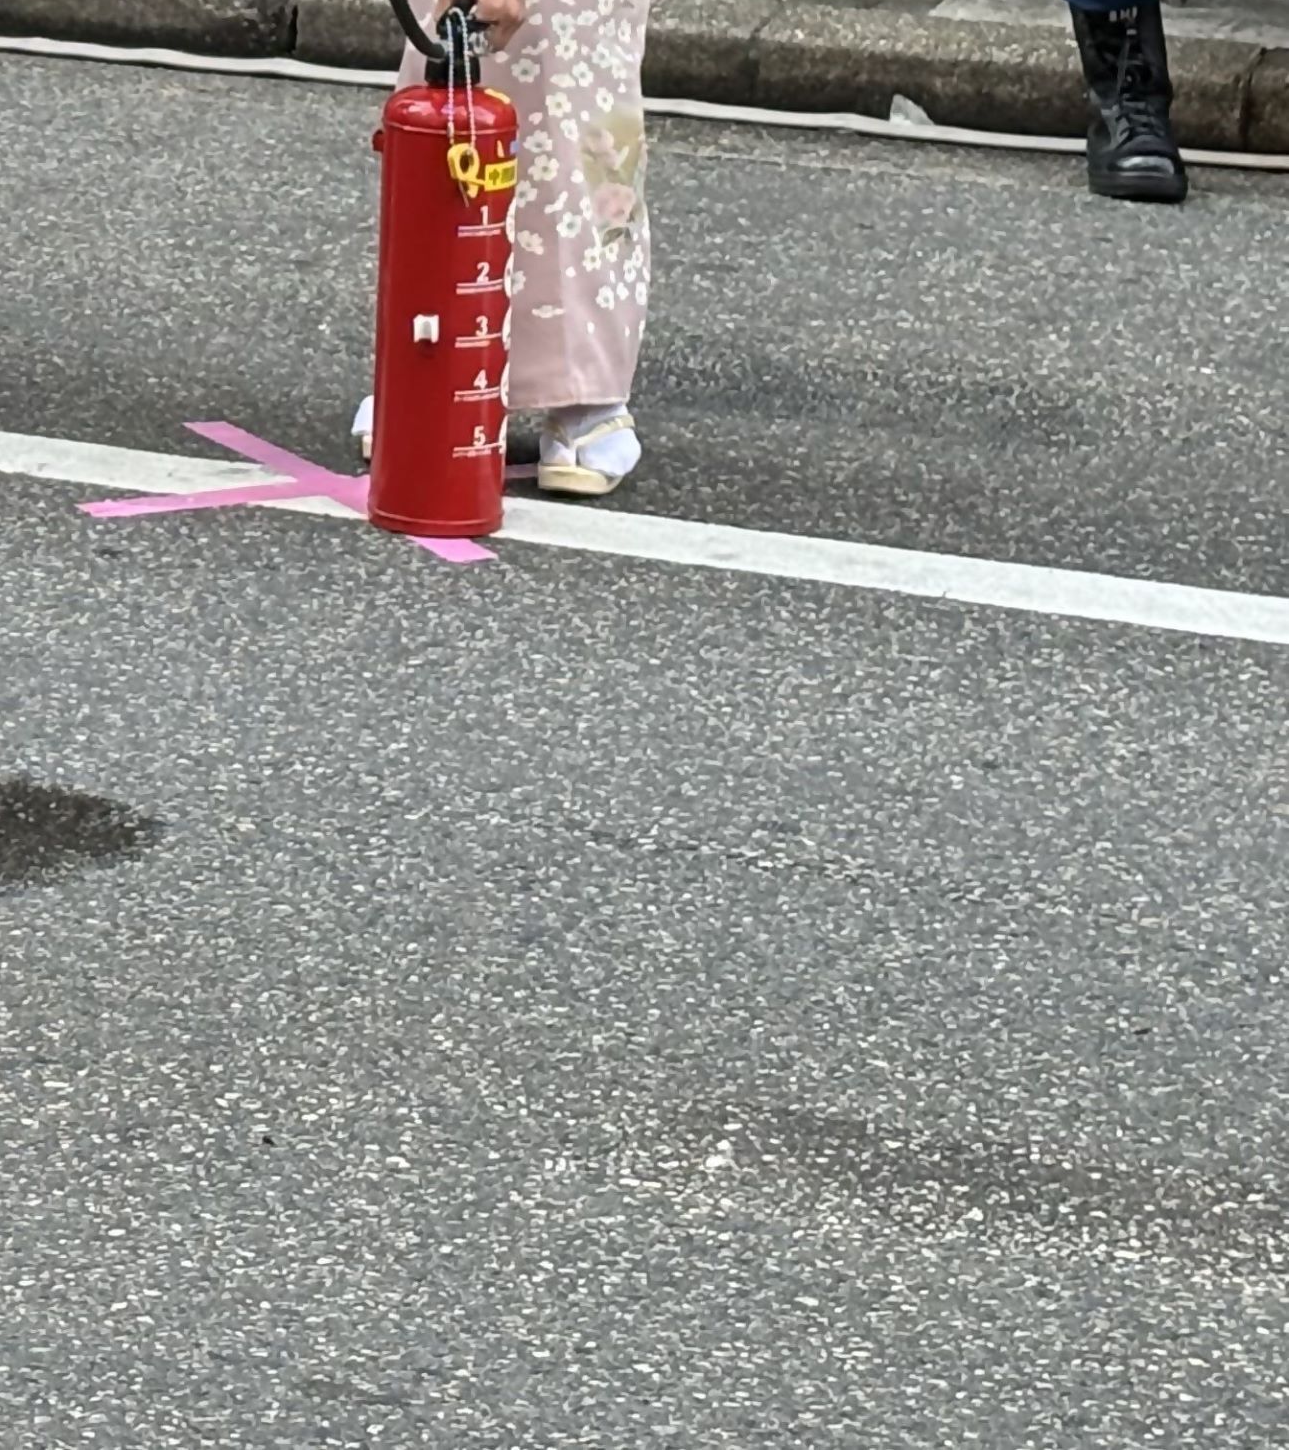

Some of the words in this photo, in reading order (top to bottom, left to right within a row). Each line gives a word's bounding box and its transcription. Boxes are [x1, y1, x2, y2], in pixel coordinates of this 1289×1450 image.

[480, 205, 489, 226] 1
[476, 261, 490, 284] 2
[475, 315, 489, 337] 3
[473, 369, 488, 390] 4
[473, 425, 486, 447] 5
